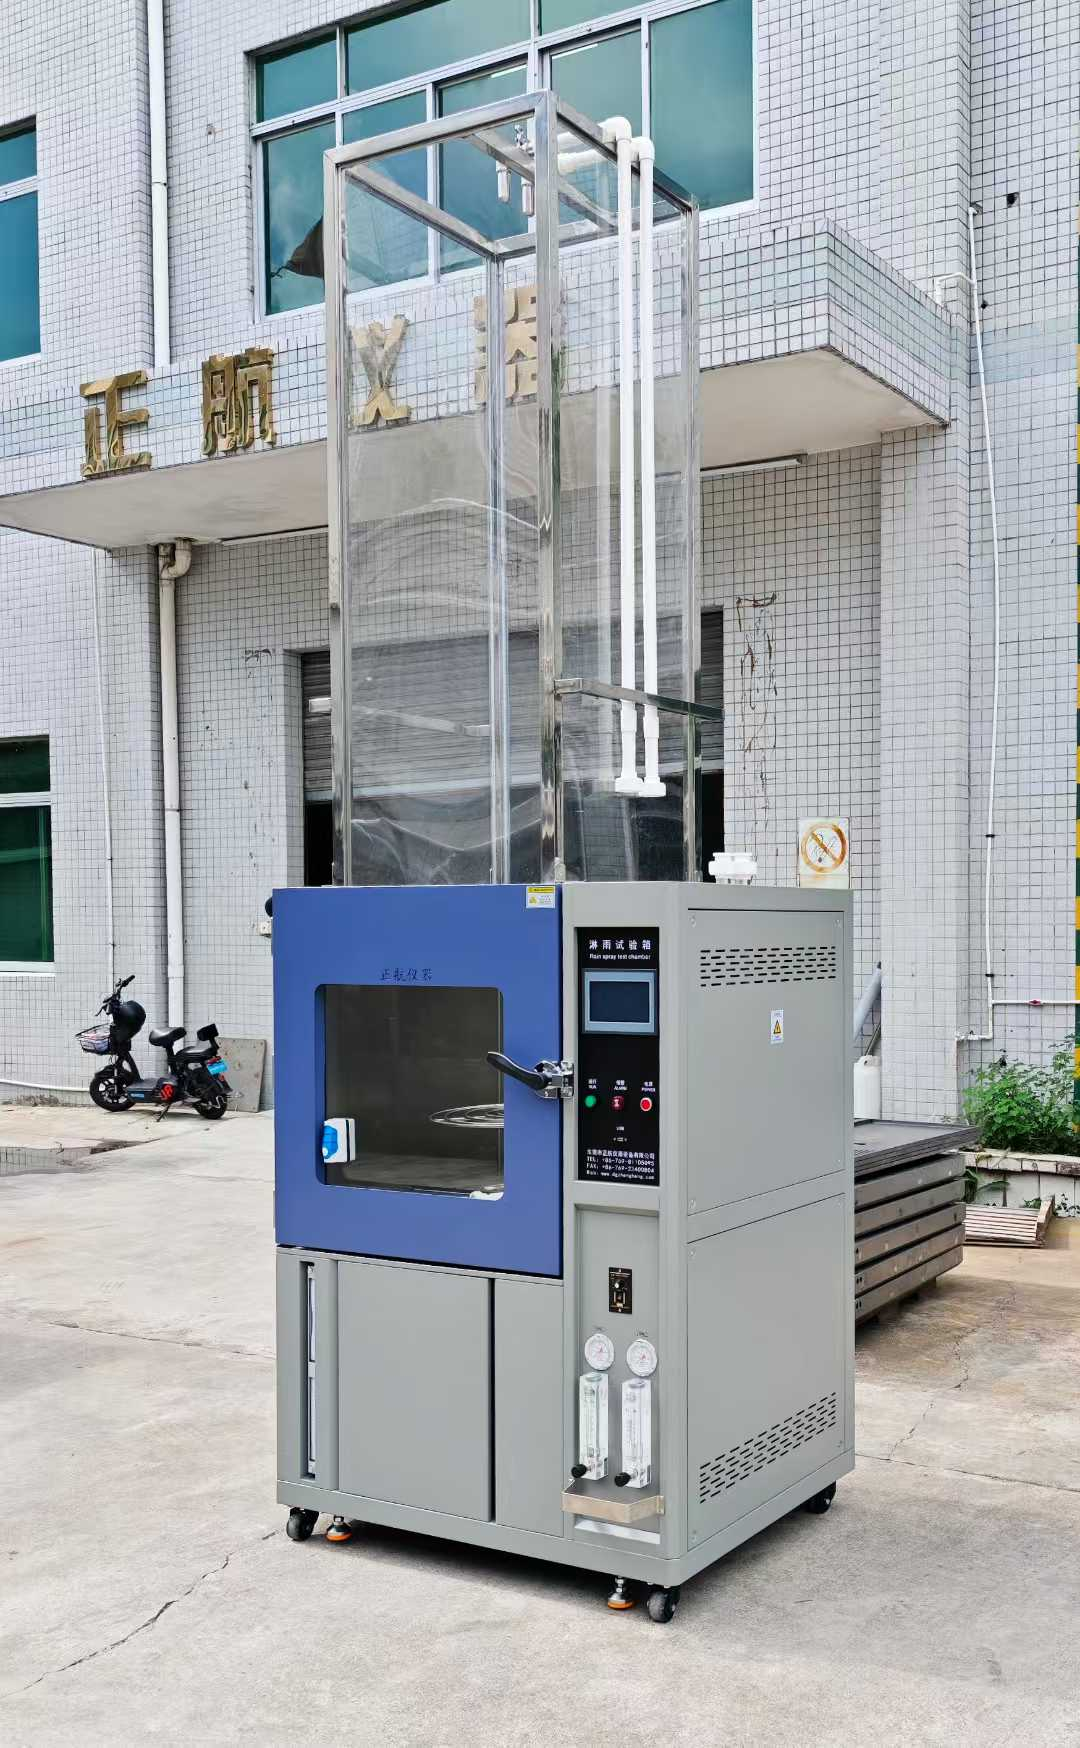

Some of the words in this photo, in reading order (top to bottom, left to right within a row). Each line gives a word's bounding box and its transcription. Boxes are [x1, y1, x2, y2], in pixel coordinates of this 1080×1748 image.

[589, 940, 650, 950] 淋雨试验箱
